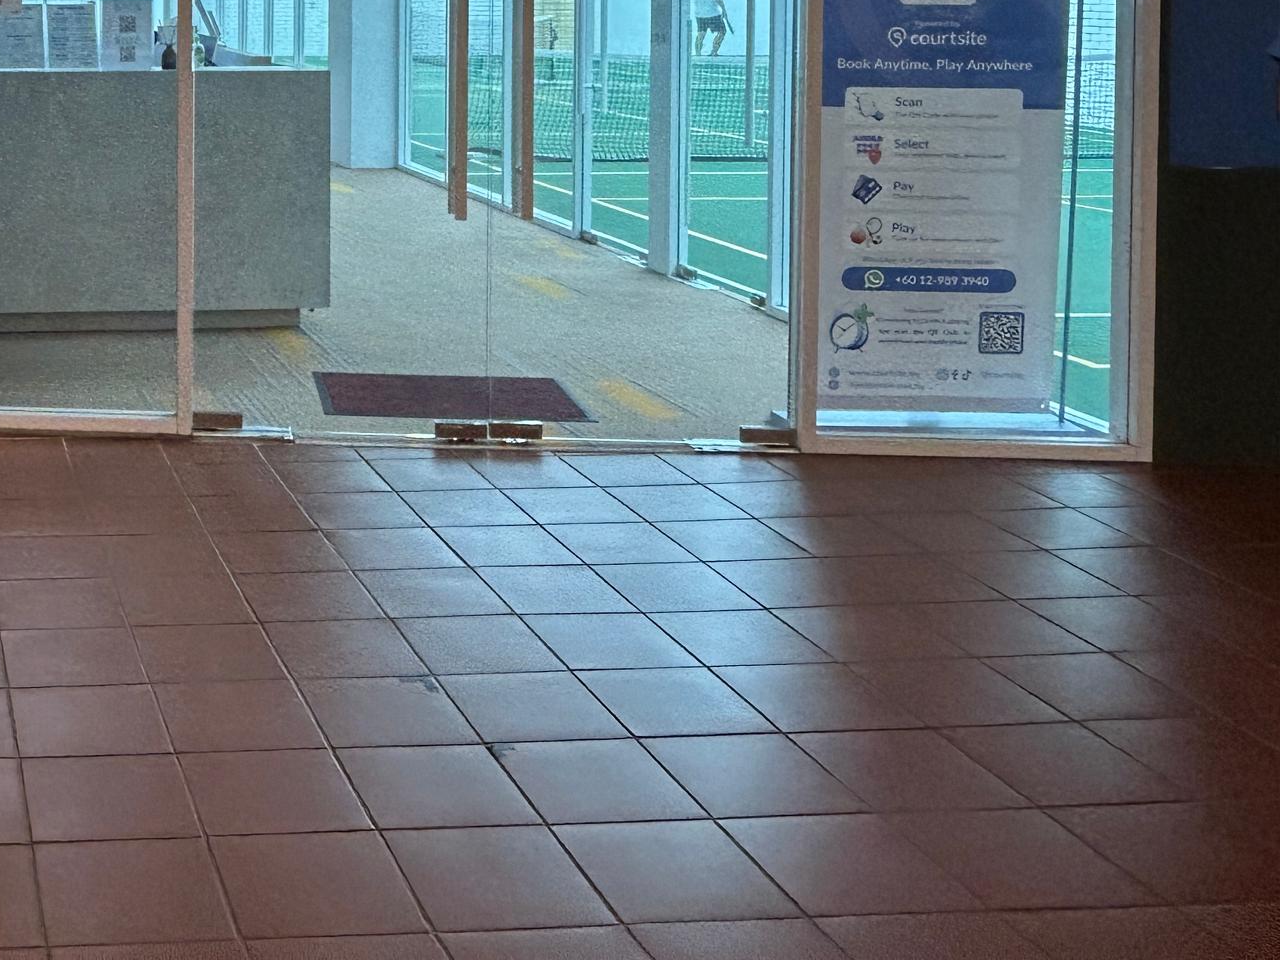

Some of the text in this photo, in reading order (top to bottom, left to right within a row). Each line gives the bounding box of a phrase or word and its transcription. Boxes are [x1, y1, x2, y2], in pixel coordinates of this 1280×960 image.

[910, 31, 987, 46] courtsite
[837, 58, 871, 69] Book
[936, 59, 964, 73] Play
[966, 60, 1033, 72] Anywhere
[895, 96, 923, 107] Scan
[894, 138, 929, 149] Select
[893, 181, 914, 191] Pay
[891, 222, 915, 234] Play
